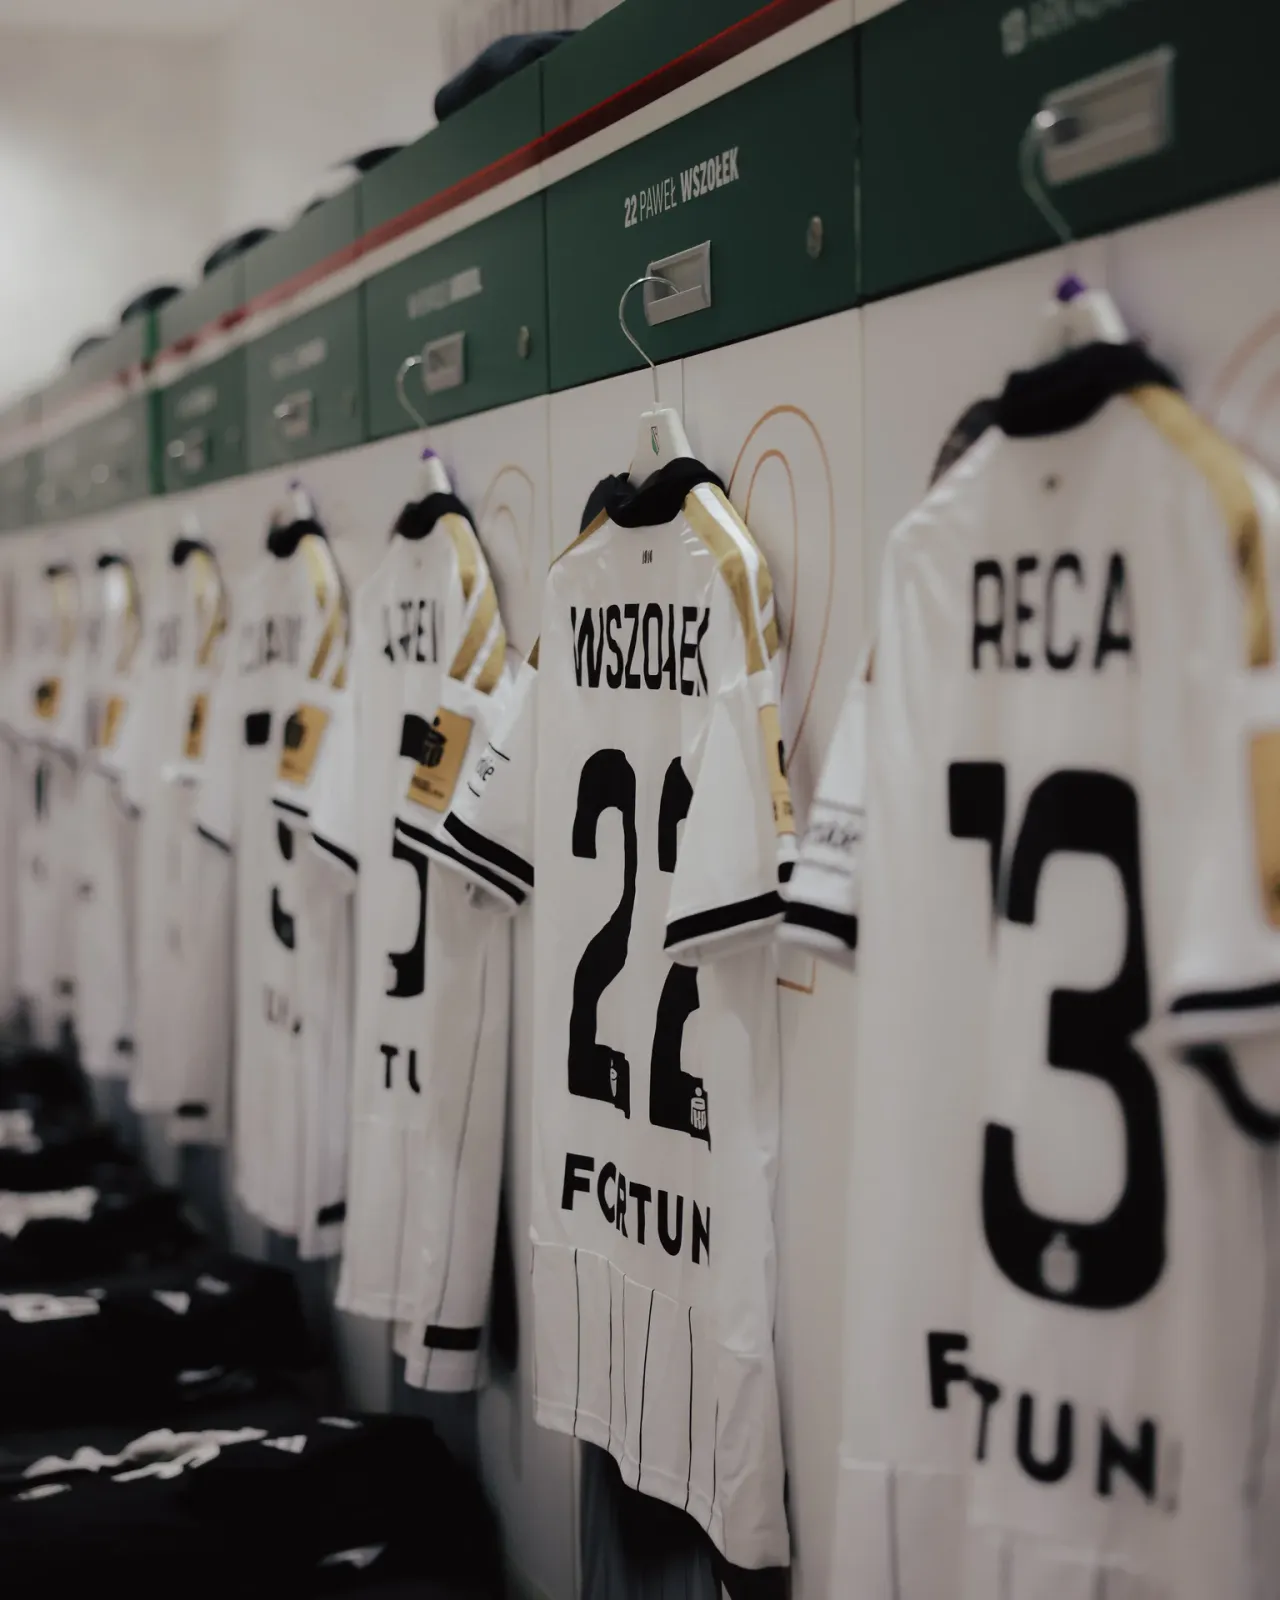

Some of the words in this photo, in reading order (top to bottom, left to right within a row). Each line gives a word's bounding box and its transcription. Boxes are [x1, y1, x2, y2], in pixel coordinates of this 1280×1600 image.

[623, 194, 638, 228] 22
[639, 176, 678, 222] PAWEŁ
[680, 146, 740, 203] WSZOŁEK
[971, 553, 1136, 671] RECA
